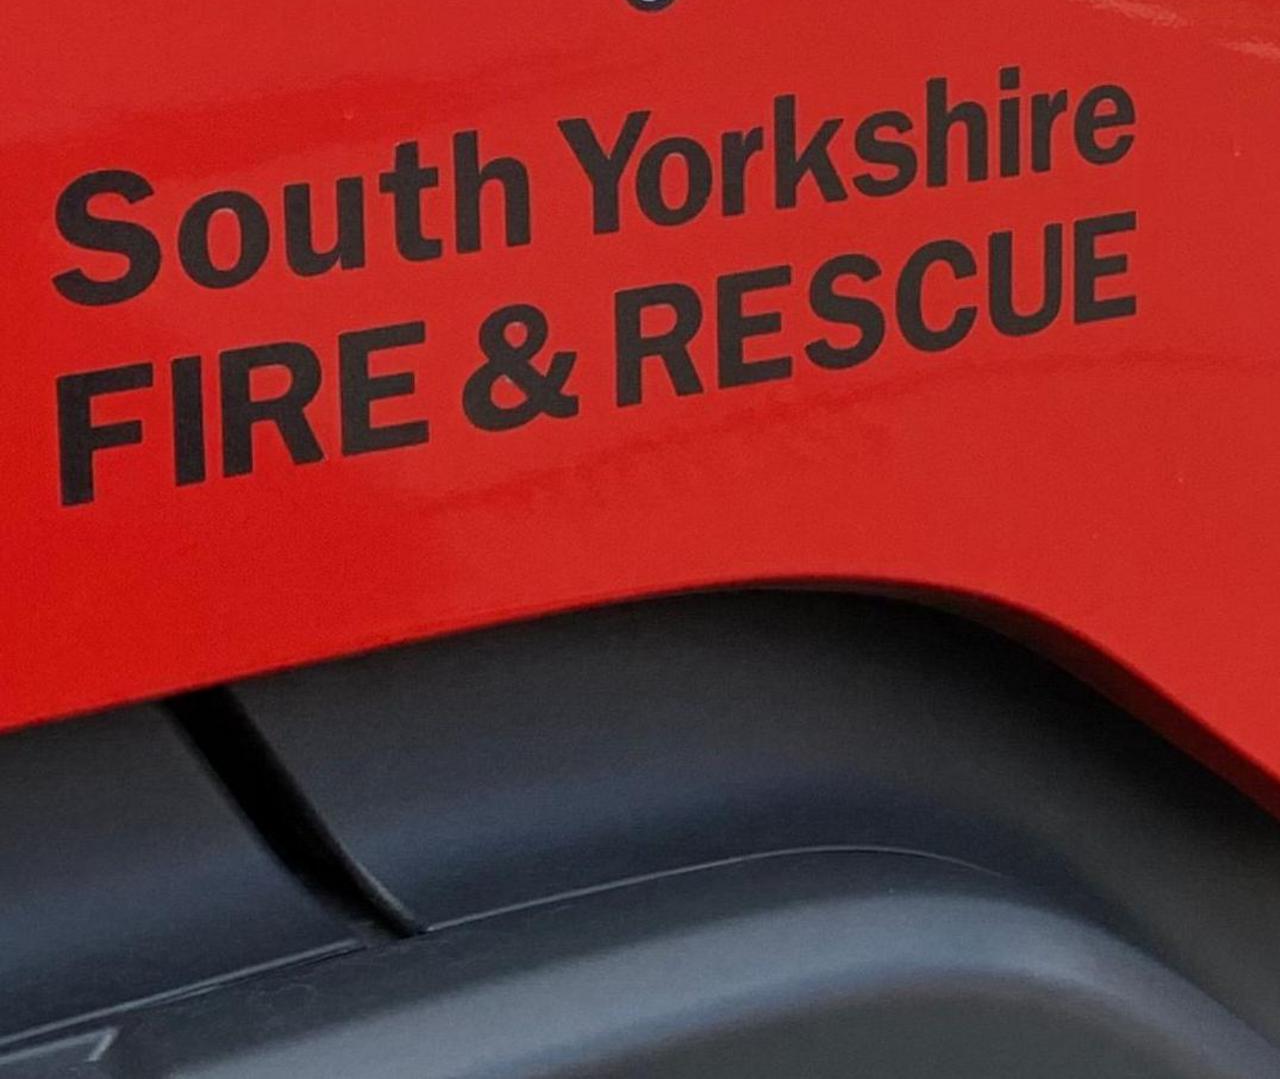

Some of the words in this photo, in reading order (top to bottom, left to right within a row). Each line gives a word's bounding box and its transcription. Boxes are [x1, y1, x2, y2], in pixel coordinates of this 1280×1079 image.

[53, 131, 531, 306] South
[559, 66, 1136, 234] Yorkshire
[56, 322, 429, 507] FIRE
[462, 304, 579, 431] &
[615, 211, 1137, 407] RESCUE
